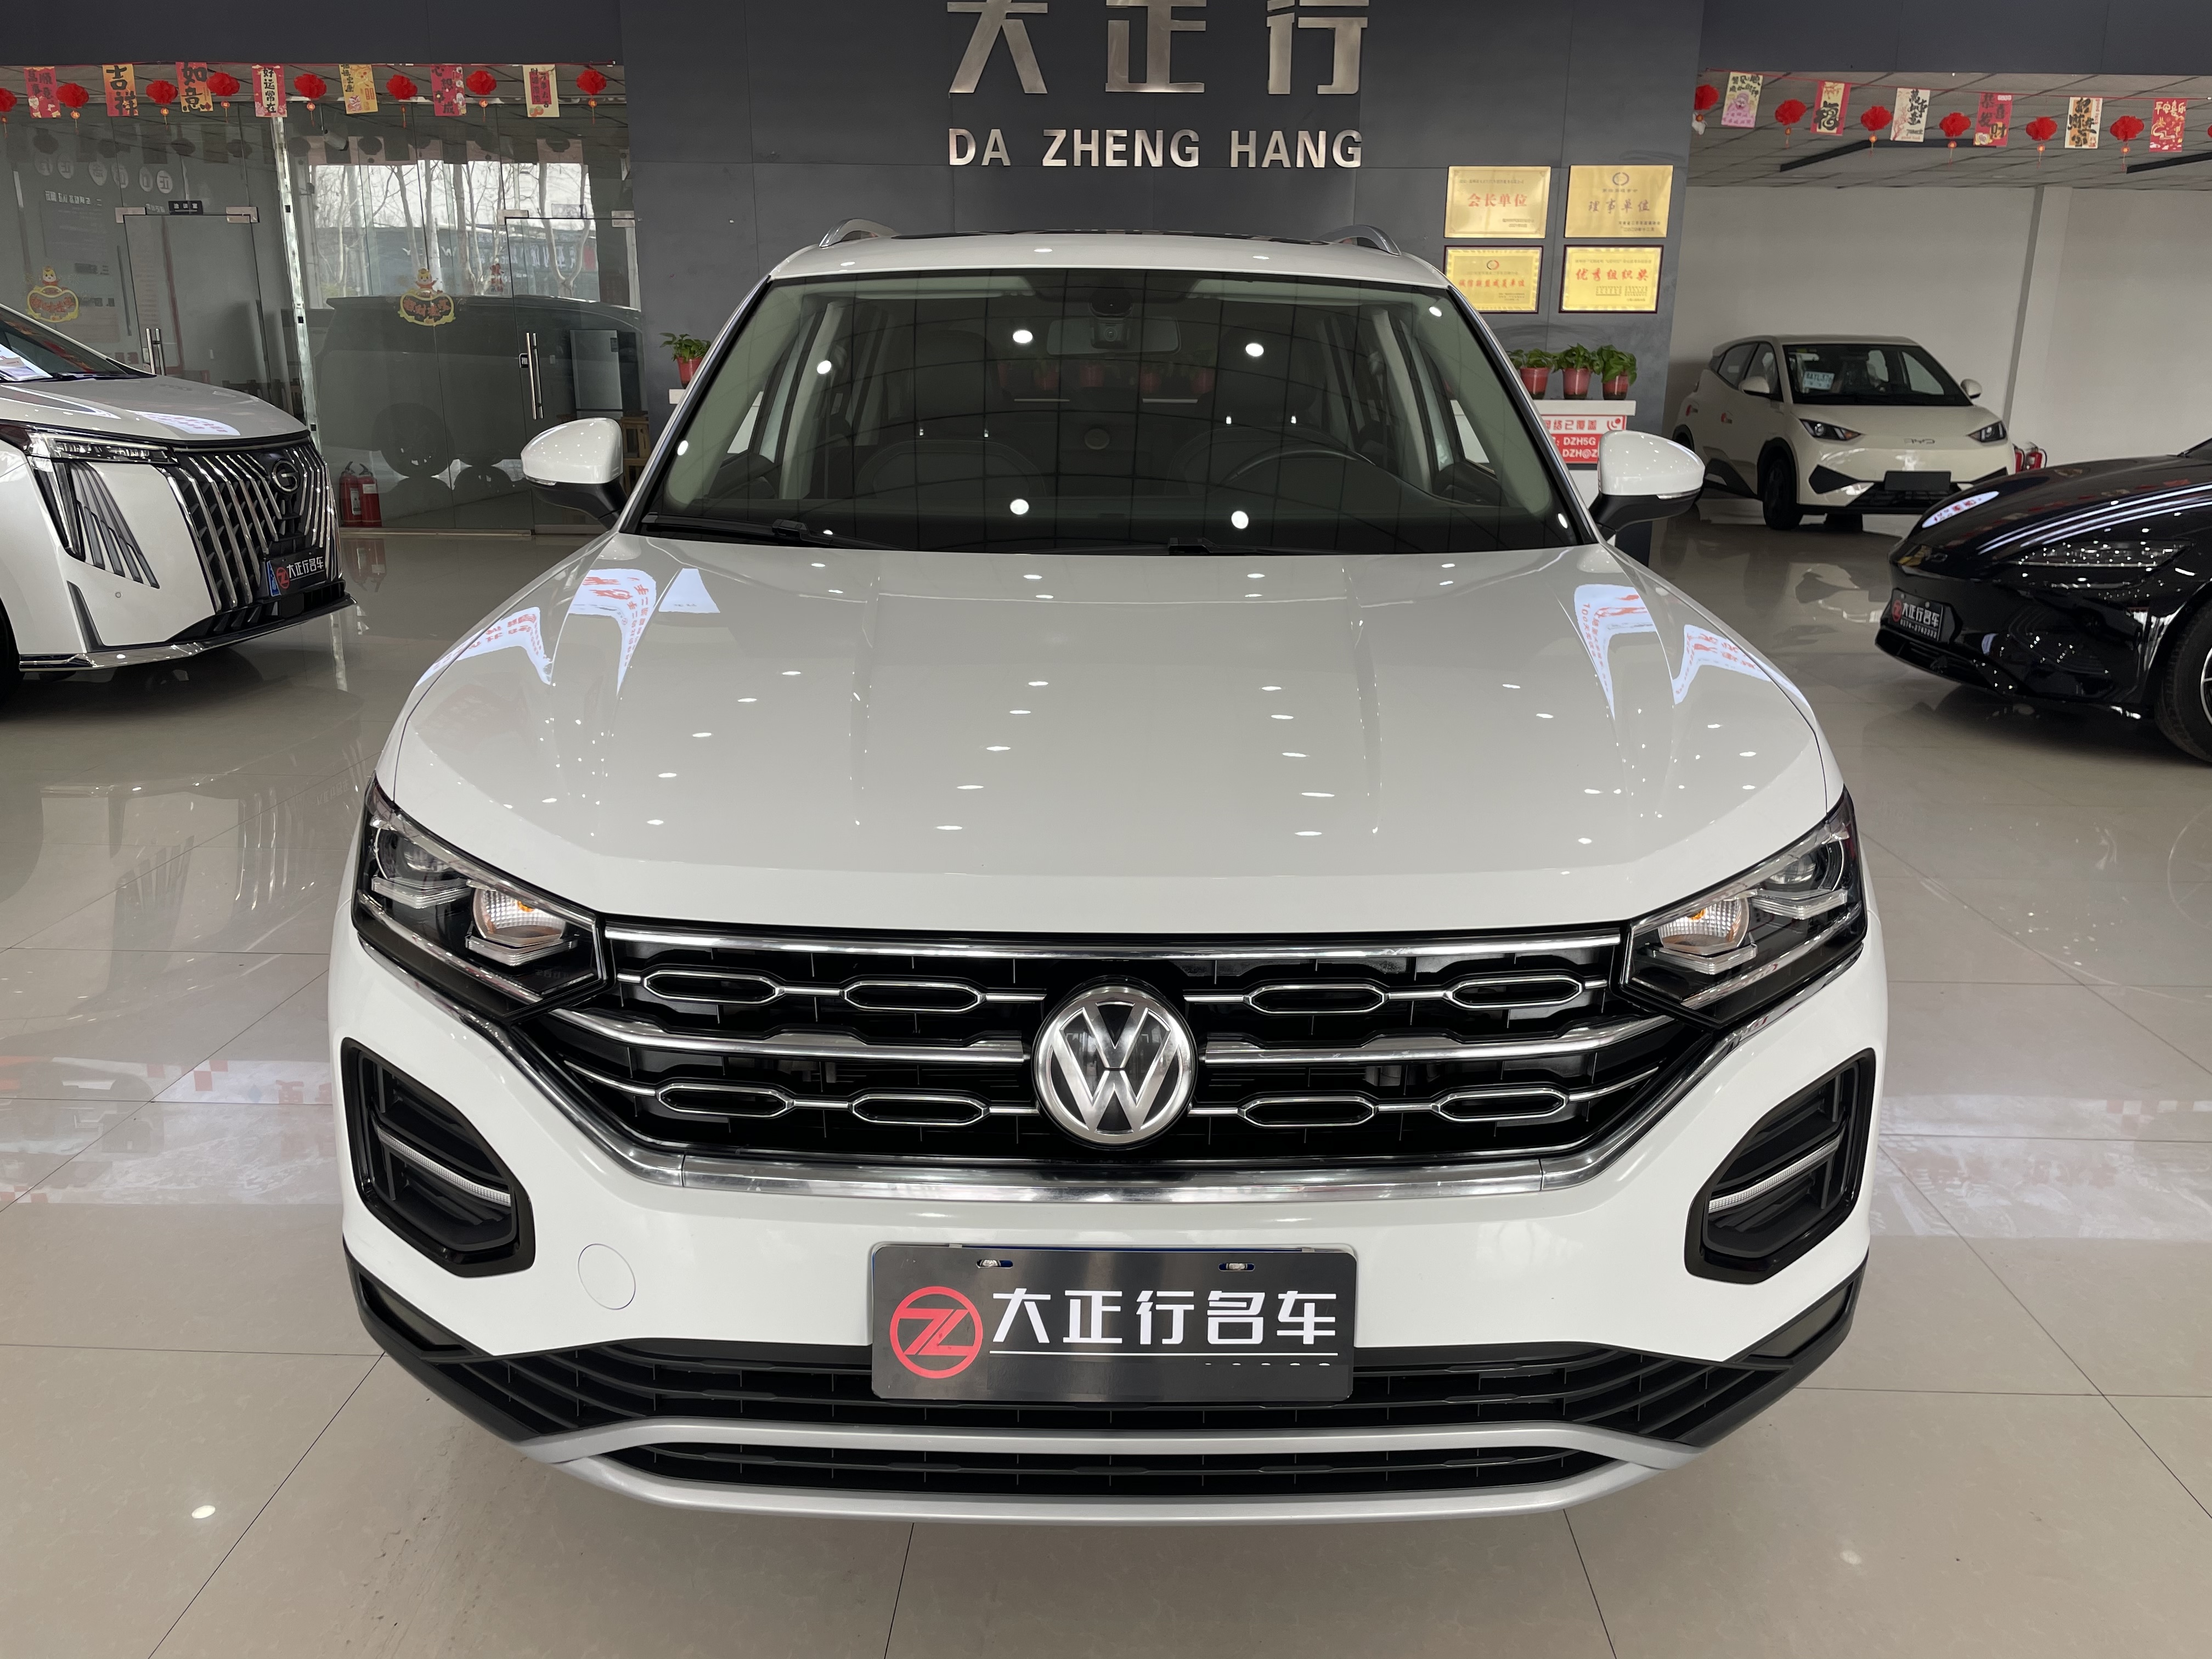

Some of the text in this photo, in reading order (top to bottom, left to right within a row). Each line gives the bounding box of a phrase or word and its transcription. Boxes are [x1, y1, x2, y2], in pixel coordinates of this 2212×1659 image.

[106, 65, 137, 115] 吉祥
[180, 61, 208, 111] 如意
[263, 67, 276, 113] 好运常在
[1814, 101, 1839, 130] 福
[949, 128, 1363, 168] DA ZHENG HANG
[1468, 193, 1527, 207] 会长单位
[1588, 198, 1650, 214] 理事单位
[1576, 267, 1649, 281] 优秀组织奖
[1564, 437, 1596, 446] DZH5G
[286, 556, 324, 578] 大正行名车
[1901, 602, 1940, 628] 大正行名车
[992, 1287, 1338, 1345] 大正行名车
